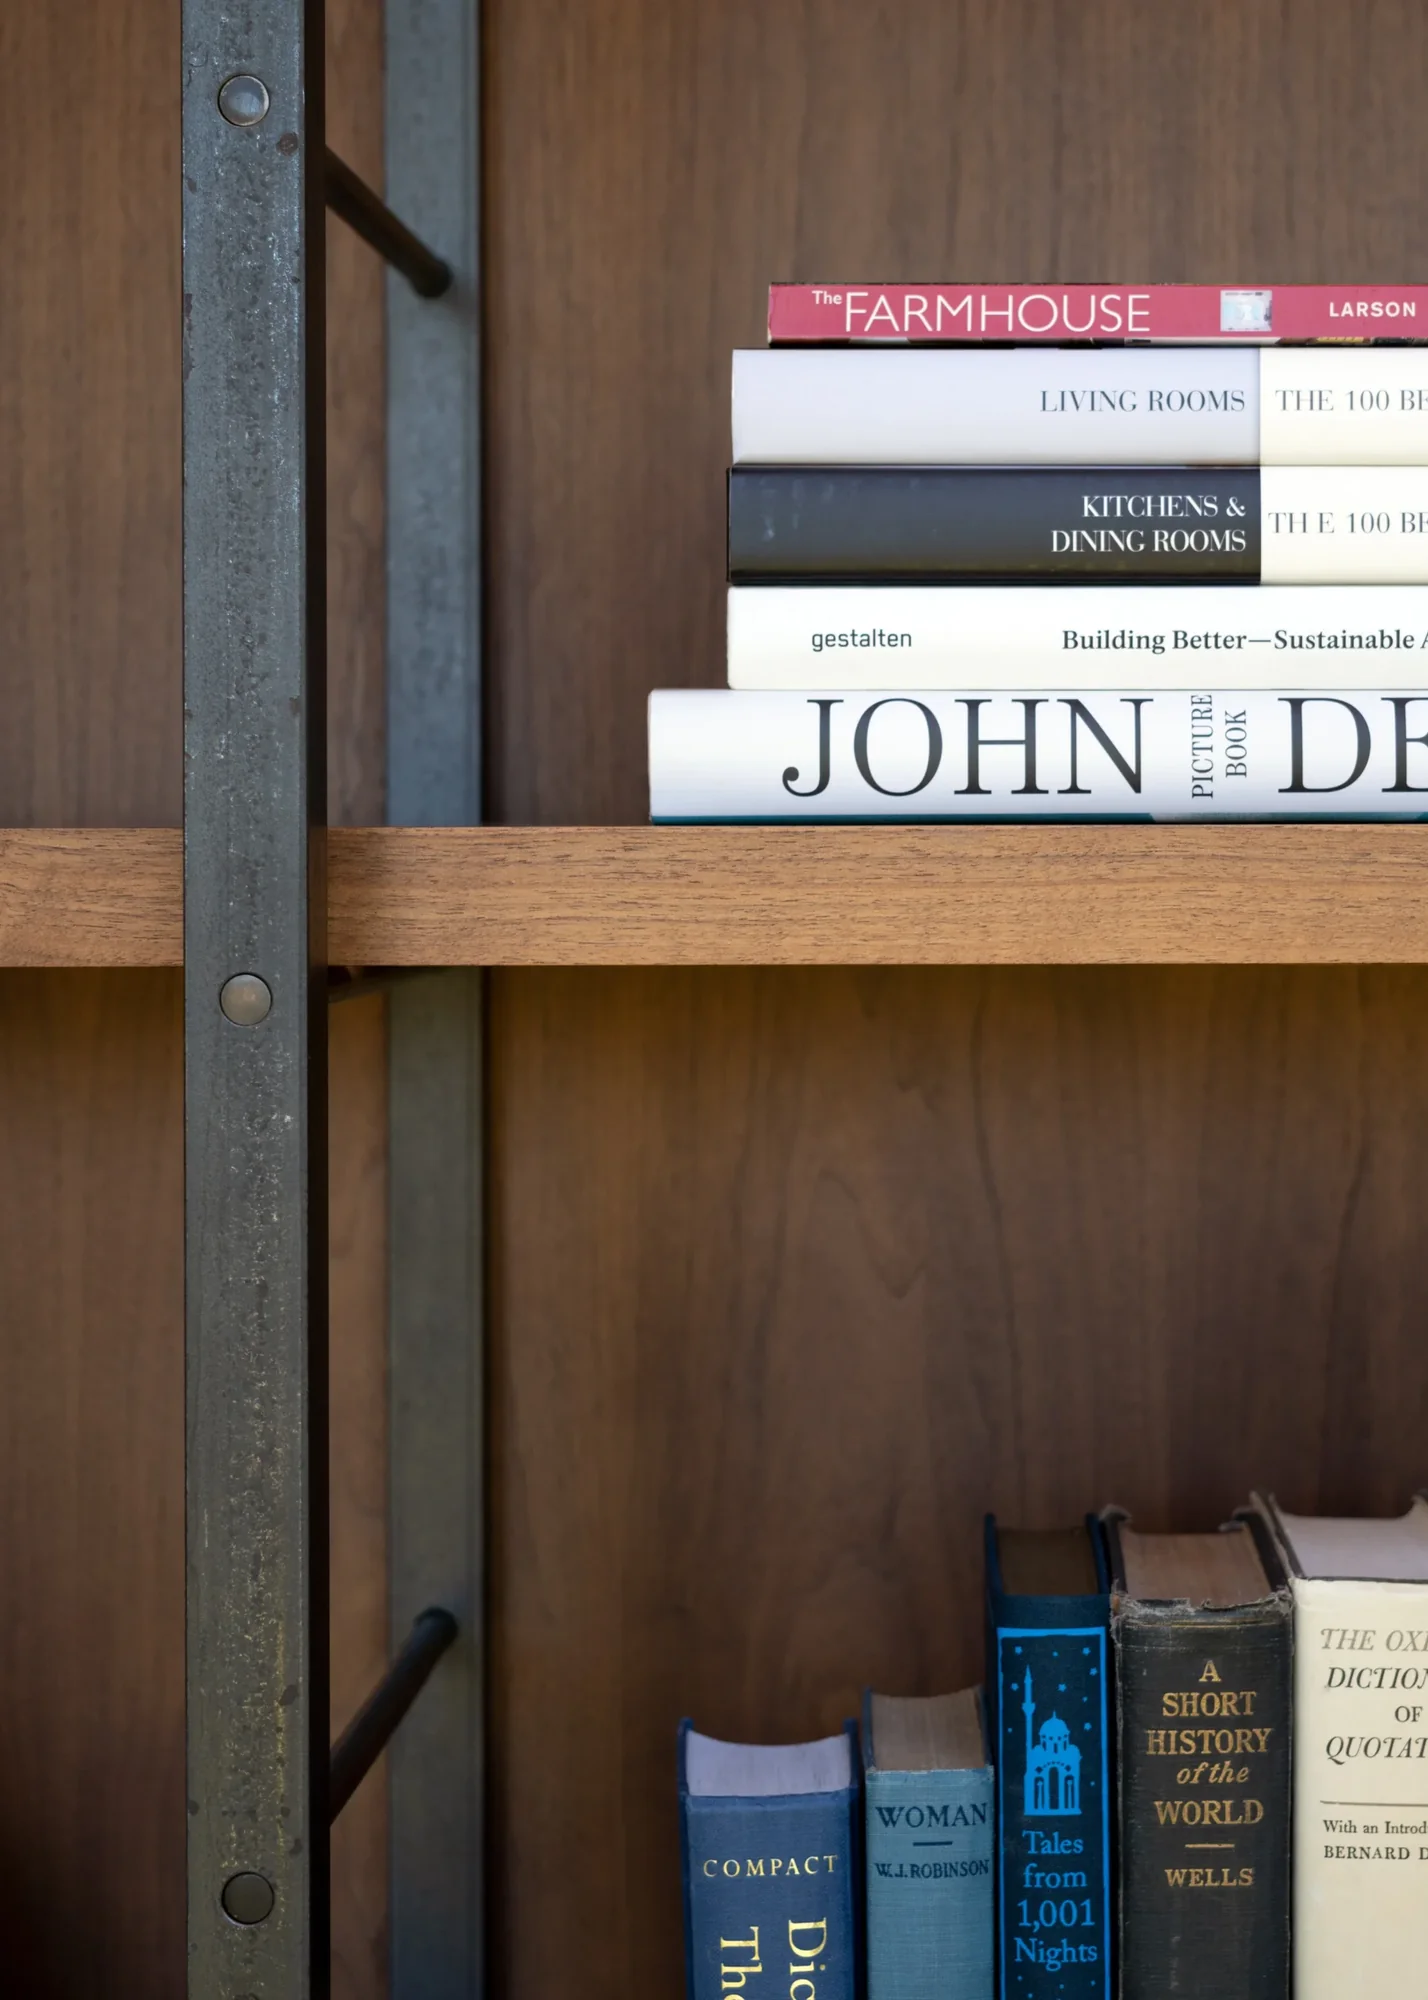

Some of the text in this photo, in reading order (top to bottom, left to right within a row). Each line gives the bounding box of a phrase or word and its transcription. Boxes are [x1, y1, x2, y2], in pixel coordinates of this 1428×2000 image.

[812, 290, 1150, 332] The FARMHOUSE
[1330, 302, 1415, 317] LARSON
[1042, 391, 1244, 411] LIVING ROOMS
[1276, 390, 1333, 410] THE
[1349, 391, 1389, 410] 100
[1084, 496, 1245, 517] KITCHENS &
[1350, 513, 1390, 532] 100
[1053, 530, 1246, 552] DINING ROOMS
[812, 629, 911, 652] gestalten
[1064, 630, 1165, 654] Building
[782, 698, 1153, 797] JOHN
[1191, 695, 1213, 798] PICTURE
[1225, 711, 1247, 777] BOOK
[1278, 698, 1428, 793] DE
[1321, 1629, 1376, 1650] THE
[1199, 1660, 1221, 1682] A
[1163, 1692, 1256, 1716] SHORT
[1395, 1706, 1422, 1722] OF
[1146, 1728, 1271, 1755] HISTORY
[1177, 1761, 1248, 1784] of the
[875, 1802, 987, 1829] WOMAN
[1154, 1800, 1263, 1825] WORLD
[1323, 1820, 1428, 1834] With an Introd
[1022, 1830, 1083, 1854] Tales
[1324, 1846, 1410, 1859] BERNARD
[704, 1855, 838, 1877] COMPACT
[874, 1859, 989, 1879] W.J.ROBINSON
[1024, 1863, 1087, 1888] from
[1165, 1868, 1252, 1887] WELLS
[1018, 1899, 1095, 1932] 1,001
[789, 1918, 826, 2000] Dic
[1015, 1938, 1097, 1971] Nights
